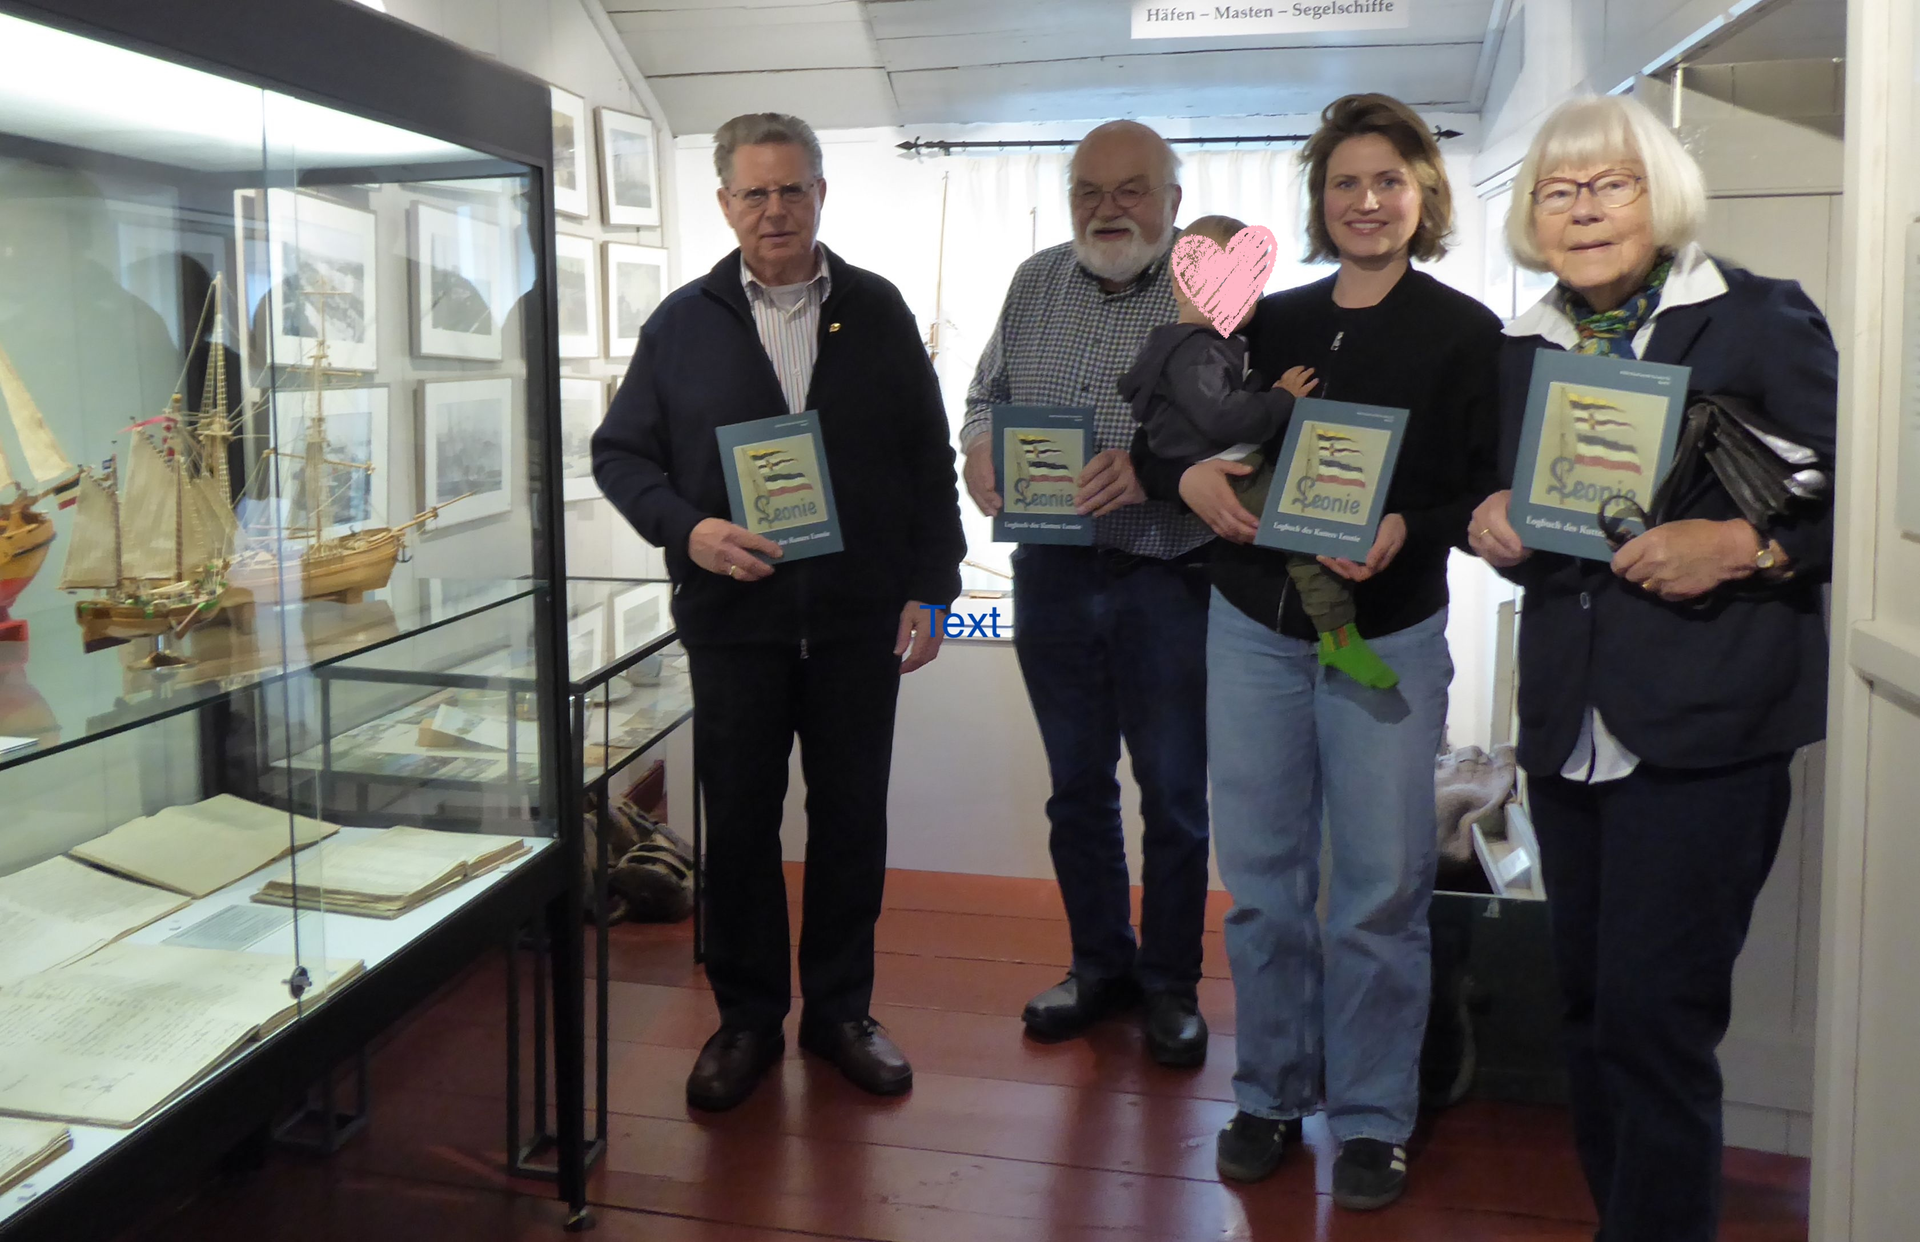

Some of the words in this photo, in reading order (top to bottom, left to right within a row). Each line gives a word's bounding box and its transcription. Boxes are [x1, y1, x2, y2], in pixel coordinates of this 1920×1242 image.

[1146, 7, 1195, 22] Häfen
[1214, 5, 1273, 20] Masten
[1292, 0, 1394, 20] Segelschiffe
[1013, 477, 1075, 507] Leonie
[1291, 475, 1361, 515] Leonie
[754, 495, 818, 525] Leonie
